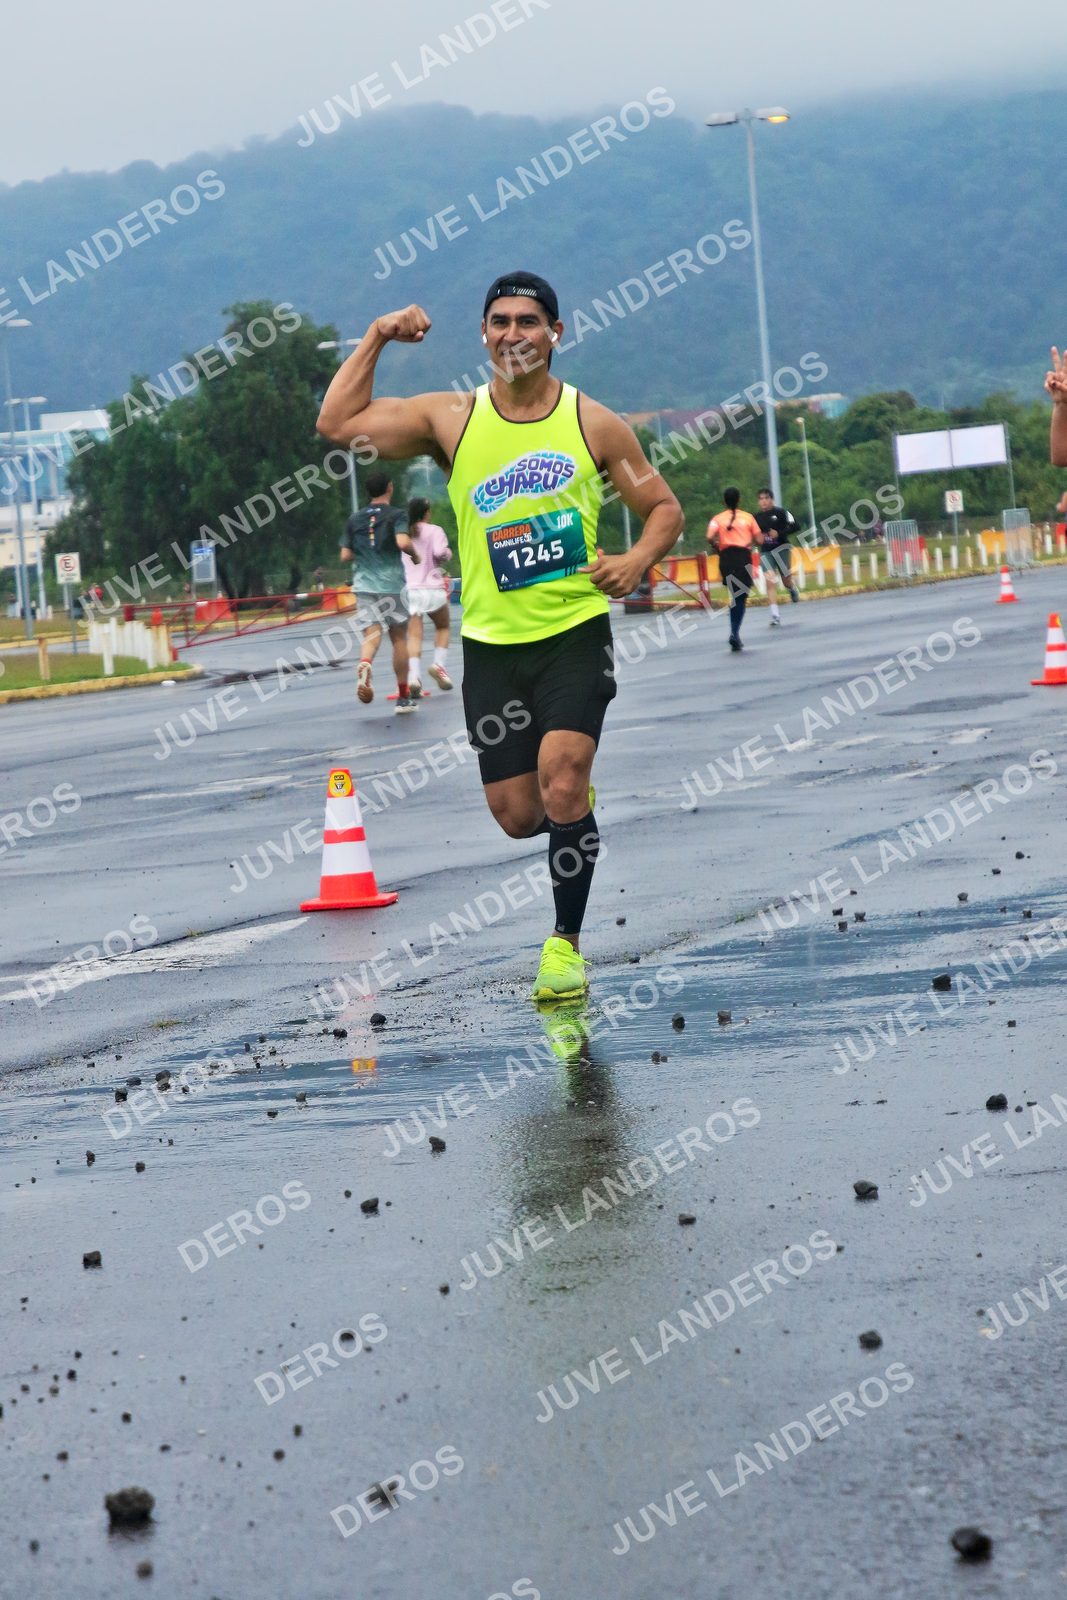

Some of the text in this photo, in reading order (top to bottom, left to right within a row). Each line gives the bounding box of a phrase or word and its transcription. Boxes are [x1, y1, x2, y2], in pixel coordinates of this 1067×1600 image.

[515, 458, 575, 478] SOMOS
[485, 471, 559, 497] CHAPU
[557, 513, 573, 529] 10K
[492, 523, 531, 541] CARRERA
[508, 539, 564, 569] 1245
